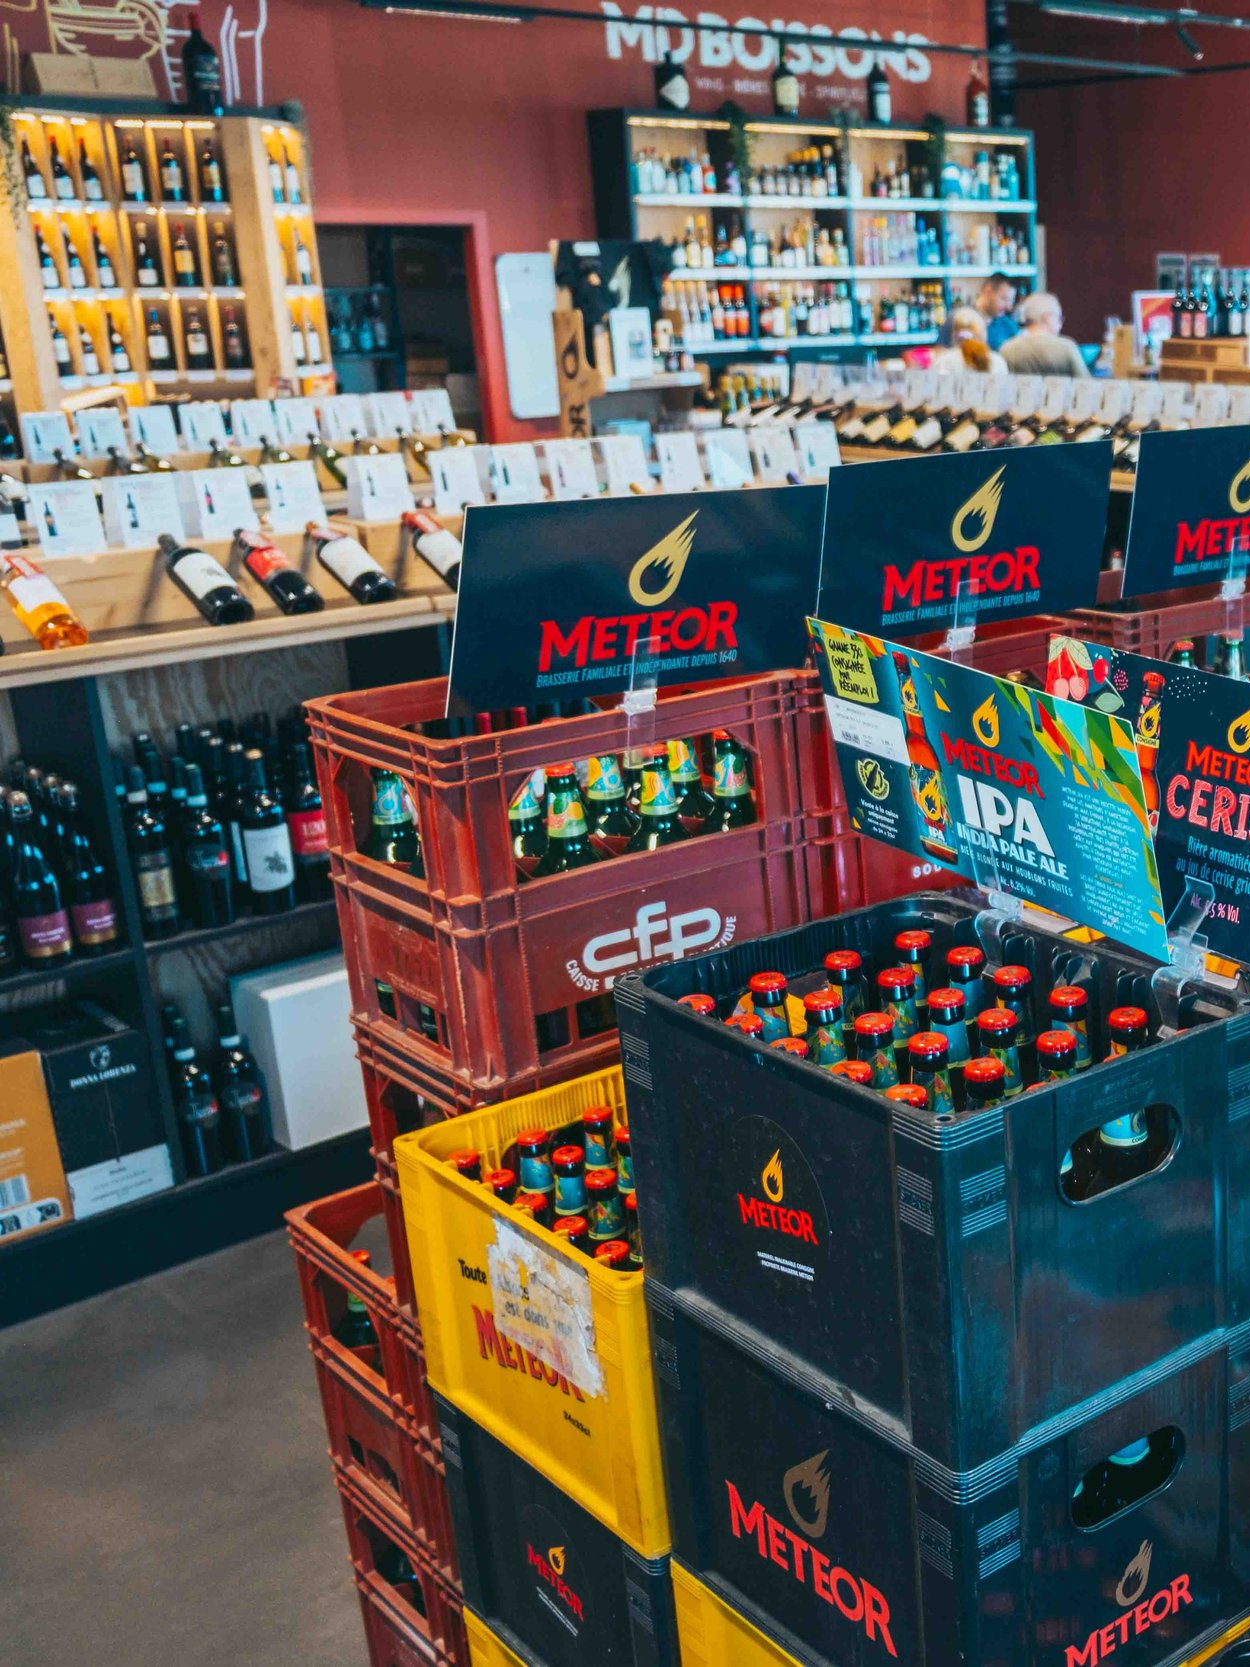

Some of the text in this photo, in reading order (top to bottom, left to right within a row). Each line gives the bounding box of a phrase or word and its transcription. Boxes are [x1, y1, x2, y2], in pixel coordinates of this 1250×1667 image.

[882, 545, 1041, 612] METEOR
[882, 610, 915, 627] BRASSERIE
[917, 603, 949, 620] FAMILIALE
[1003, 593, 1024, 606] DEPUIS
[538, 600, 738, 672] METEOR
[536, 671, 580, 688] BRASSERIE
[582, 665, 621, 682] FAMILIALE
[622, 664, 633, 677] ET
[691, 652, 717, 667] DEPUIS
[718, 649, 737, 664] 1640
[940, 731, 1045, 799] METEOR
[957, 774, 1056, 858] IPA
[956, 822, 1070, 880] INDIA PALE ALE
[1188, 836, 1207, 858] Bière
[1001, 860, 1014, 874] AUX
[1015, 865, 1047, 887] HOUBLONS
[1176, 857, 1185, 872] au
[1186, 860, 1199, 880] jus
[1200, 864, 1209, 880] de
[1211, 869, 1235, 889] cerise
[1217, 903, 1240, 924] % Vol.
[566, 959, 600, 992] CAISSE
[70, 1073, 98, 1089] DONNA
[737, 1193, 819, 1246] METEOR
[458, 1258, 488, 1285] Toute
[527, 1543, 584, 1622] METEOR
[724, 1479, 898, 1659] METEOR
[1064, 1573, 1194, 1667] METEOR
